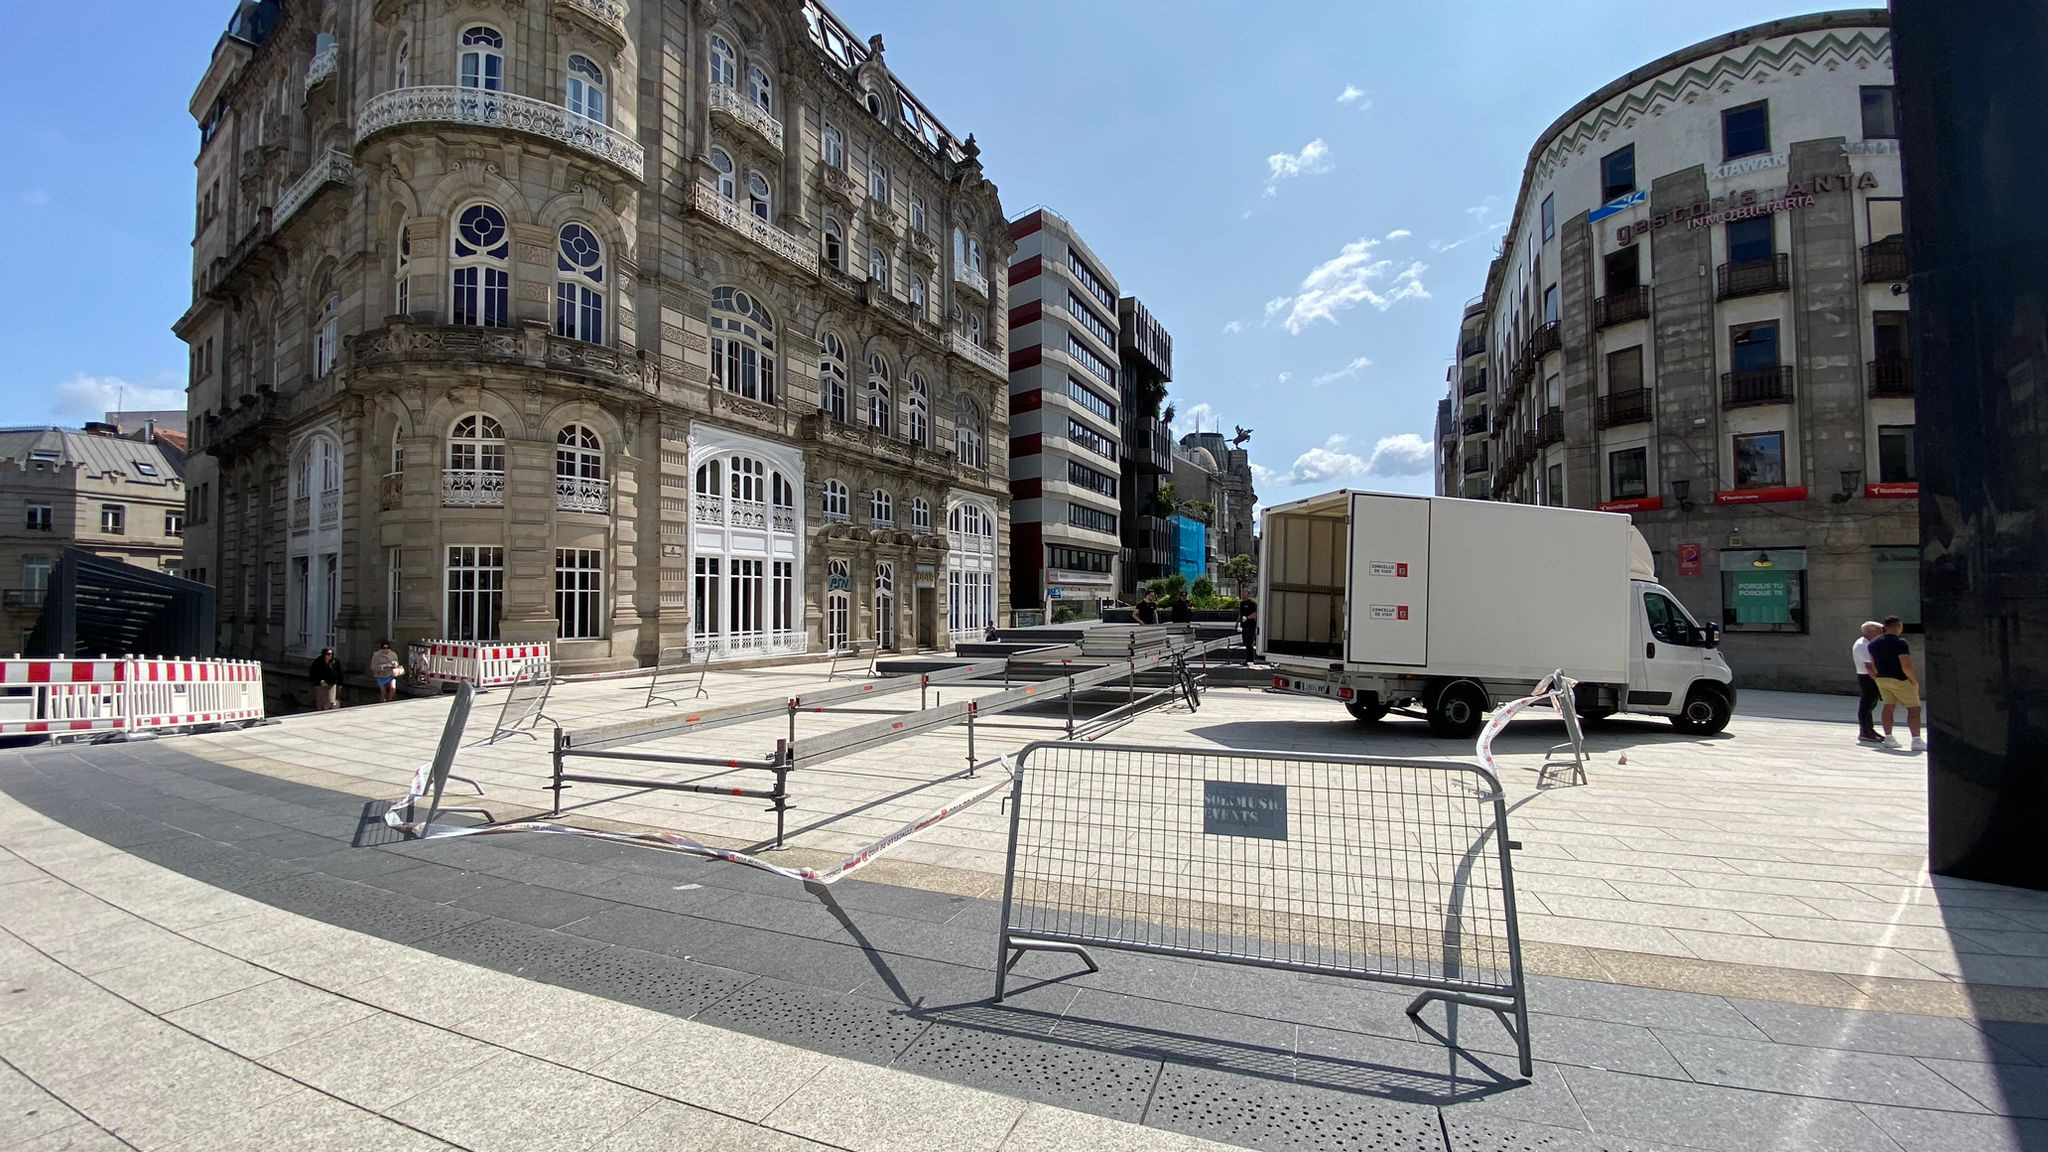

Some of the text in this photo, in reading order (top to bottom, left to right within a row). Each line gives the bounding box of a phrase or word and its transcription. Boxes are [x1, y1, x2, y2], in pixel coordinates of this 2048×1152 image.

[1784, 171, 1880, 198] ANTA
[1686, 194, 1816, 232] INMOBILIARIA
[830, 578, 849, 589] PSN
